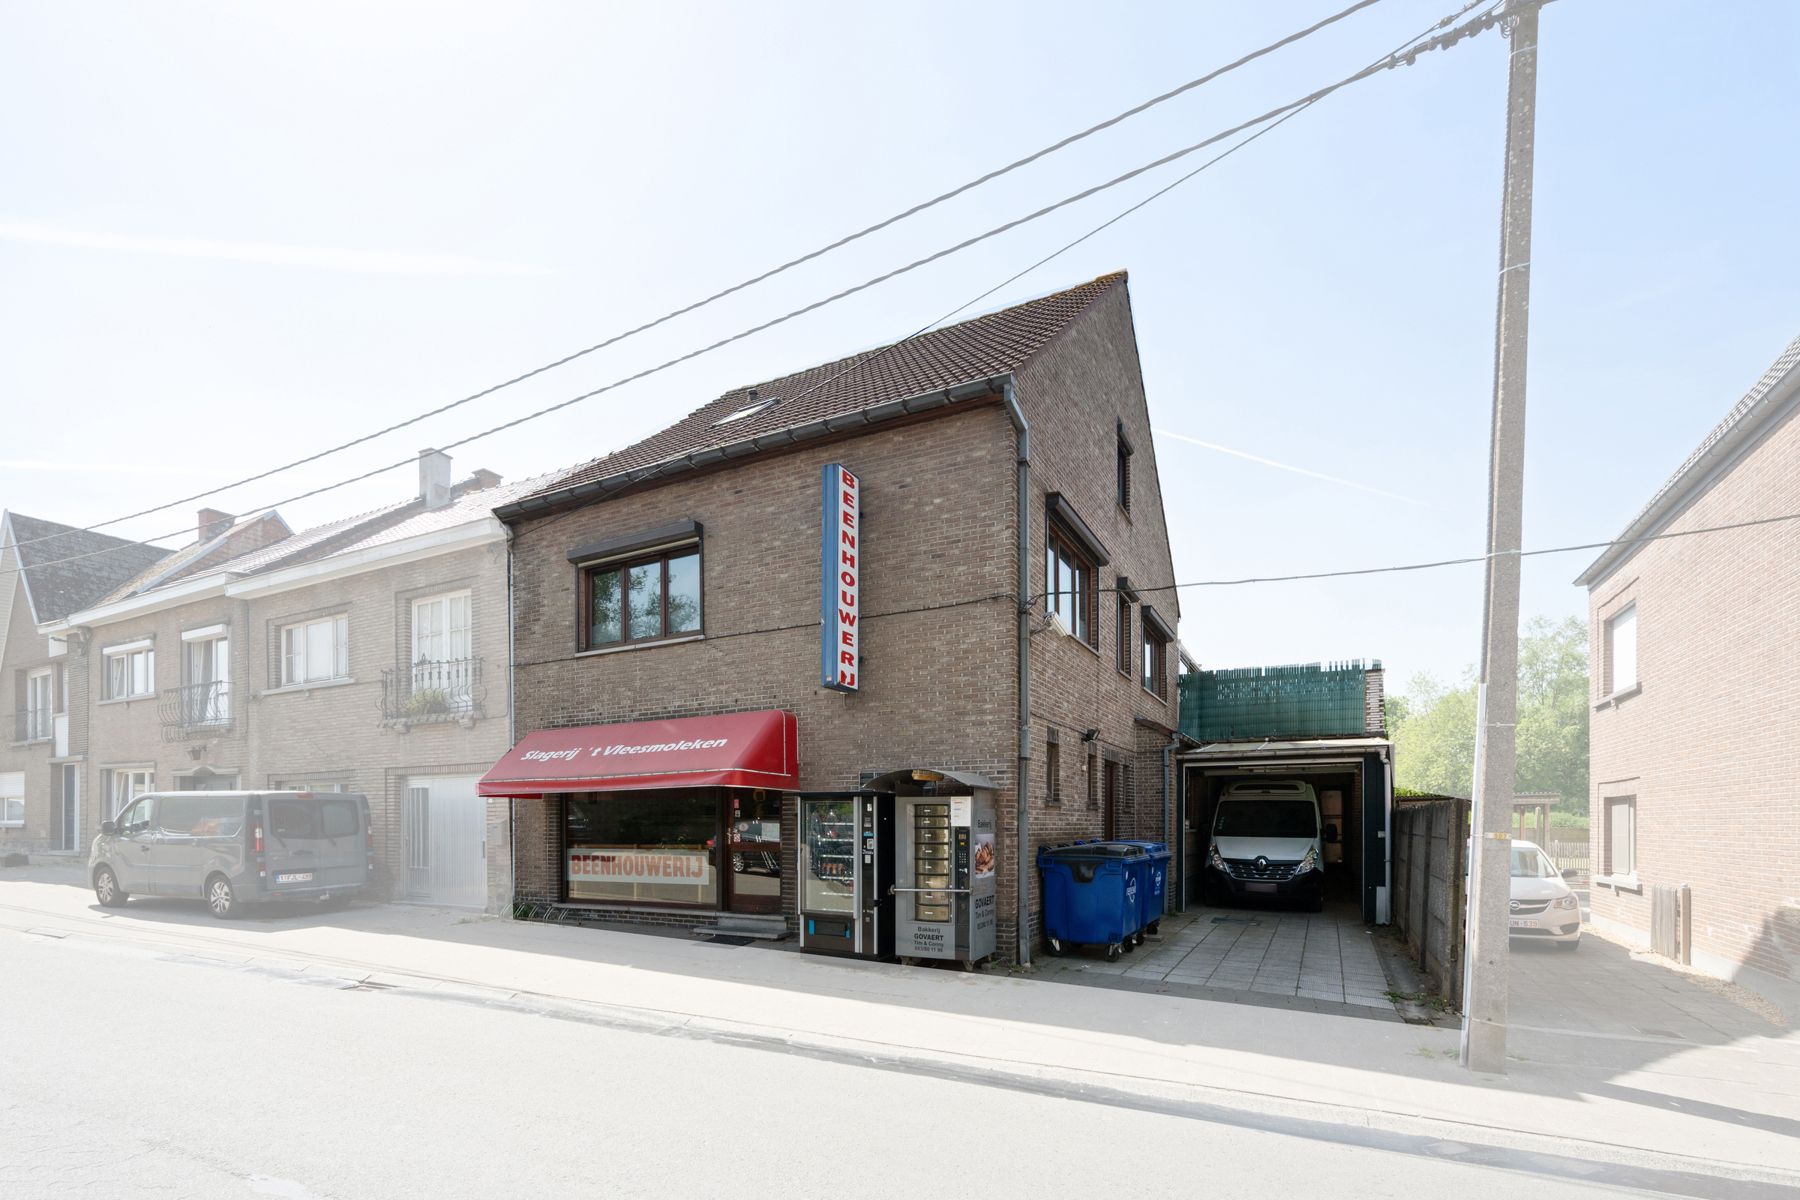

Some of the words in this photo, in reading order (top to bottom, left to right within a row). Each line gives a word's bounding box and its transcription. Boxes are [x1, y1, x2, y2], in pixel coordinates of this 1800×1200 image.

[839, 469, 856, 686] BEENHOUWERIJ
[520, 748, 582, 762] Slagerij
[603, 738, 728, 756] Vleesmoleken
[571, 855, 704, 878] BEENHOUWERIJ
[914, 933, 944, 941] GOVAERT
[917, 926, 941, 934] Bakkerij
